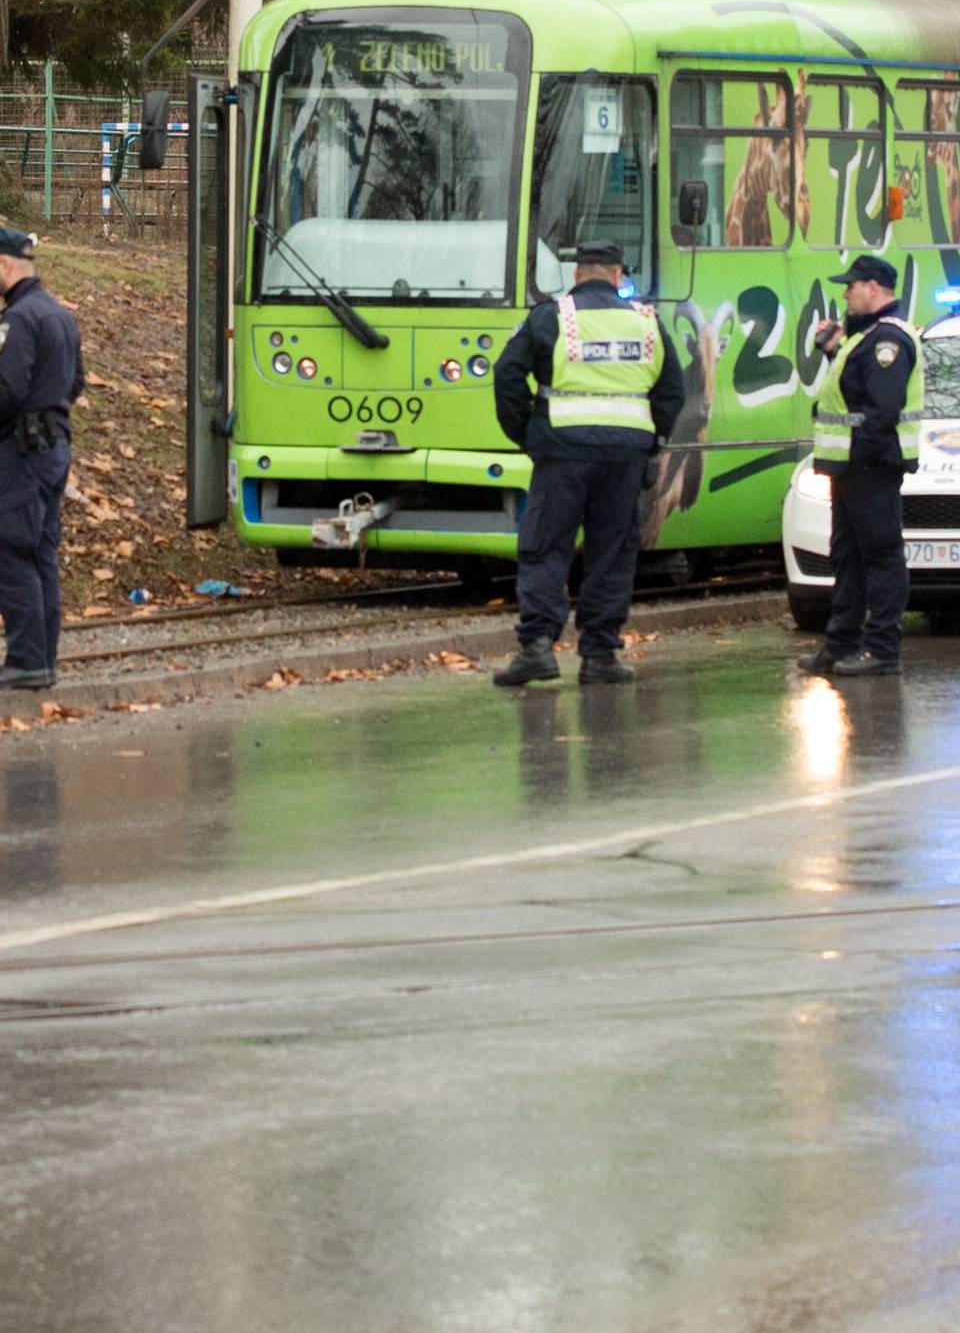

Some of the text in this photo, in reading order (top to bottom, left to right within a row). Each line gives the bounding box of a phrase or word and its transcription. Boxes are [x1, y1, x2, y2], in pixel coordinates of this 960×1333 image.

[455, 42, 505, 72] POL
[598, 106, 609, 128] 6
[327, 395, 424, 424] 0609
